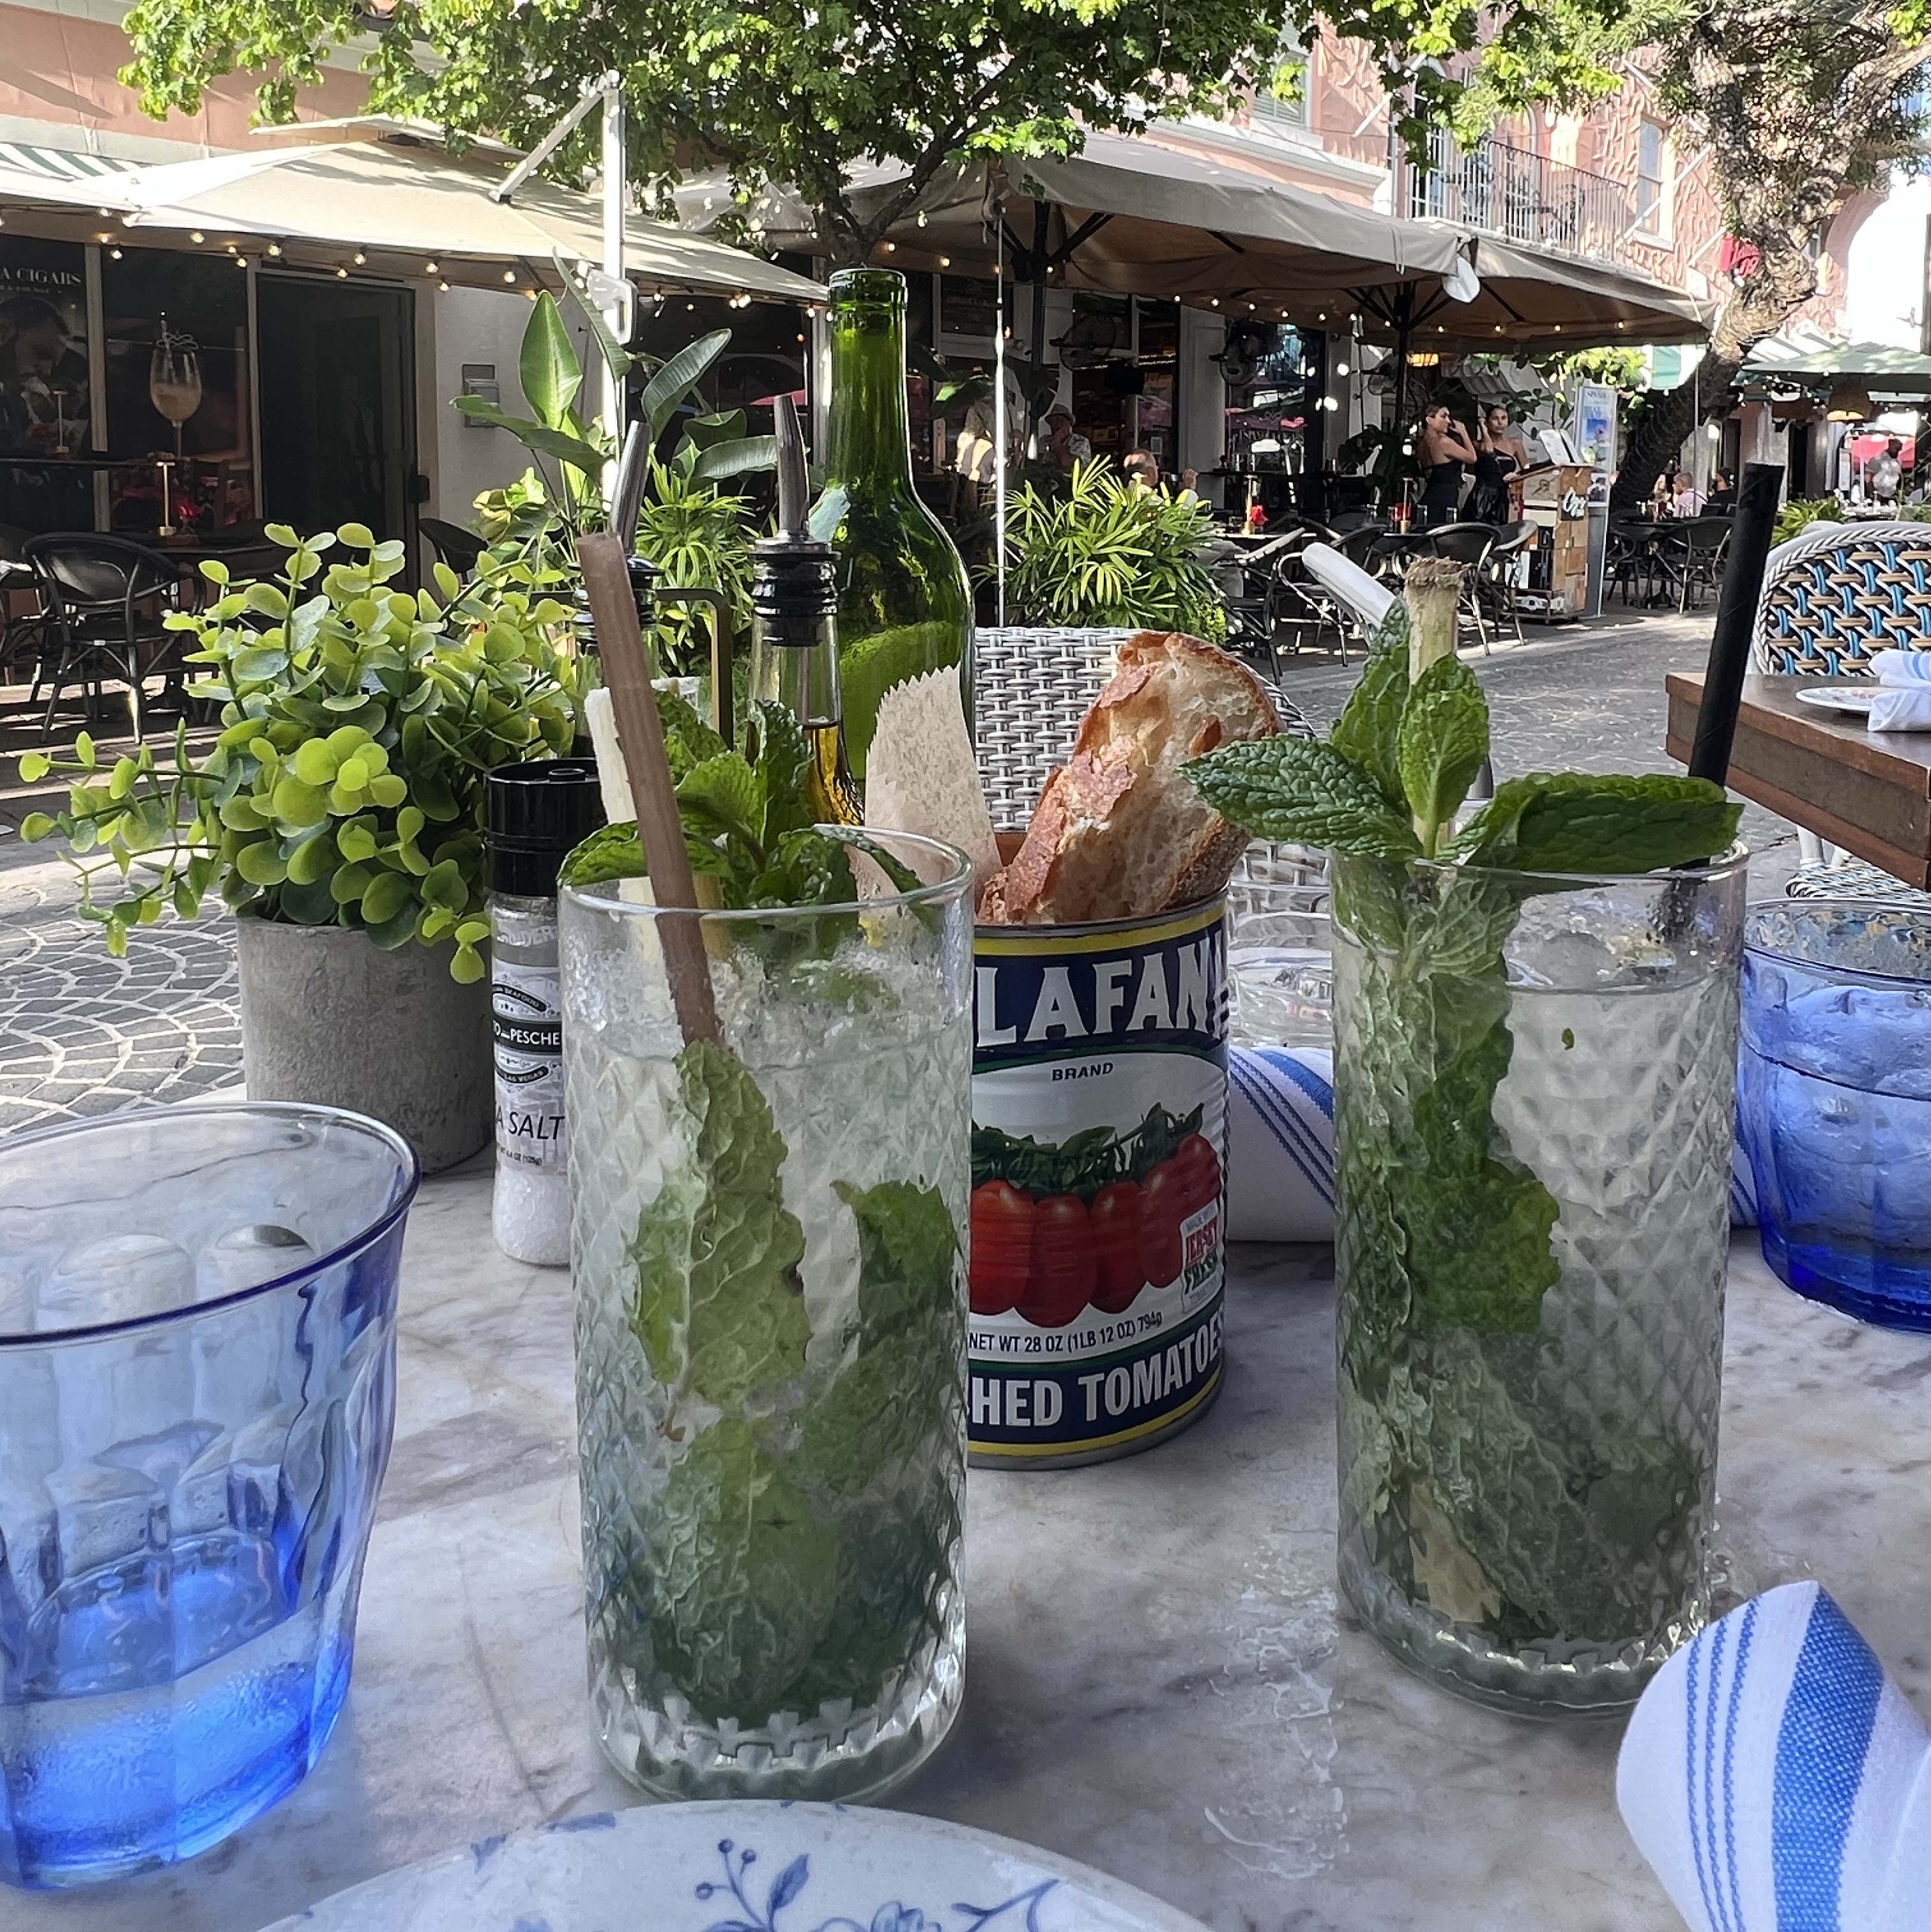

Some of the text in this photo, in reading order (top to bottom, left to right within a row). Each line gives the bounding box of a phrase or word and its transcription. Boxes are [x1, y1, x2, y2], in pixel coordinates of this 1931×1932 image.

[16, 267, 82, 287] CIGARS
[1052, 1062, 1113, 1081] BRAND
[508, 1112, 565, 1140] SALT
[968, 1310, 1163, 1354] NET WT 28 OZ (1LB 12 OZ) 794g
[972, 1376, 1063, 1427] HED
